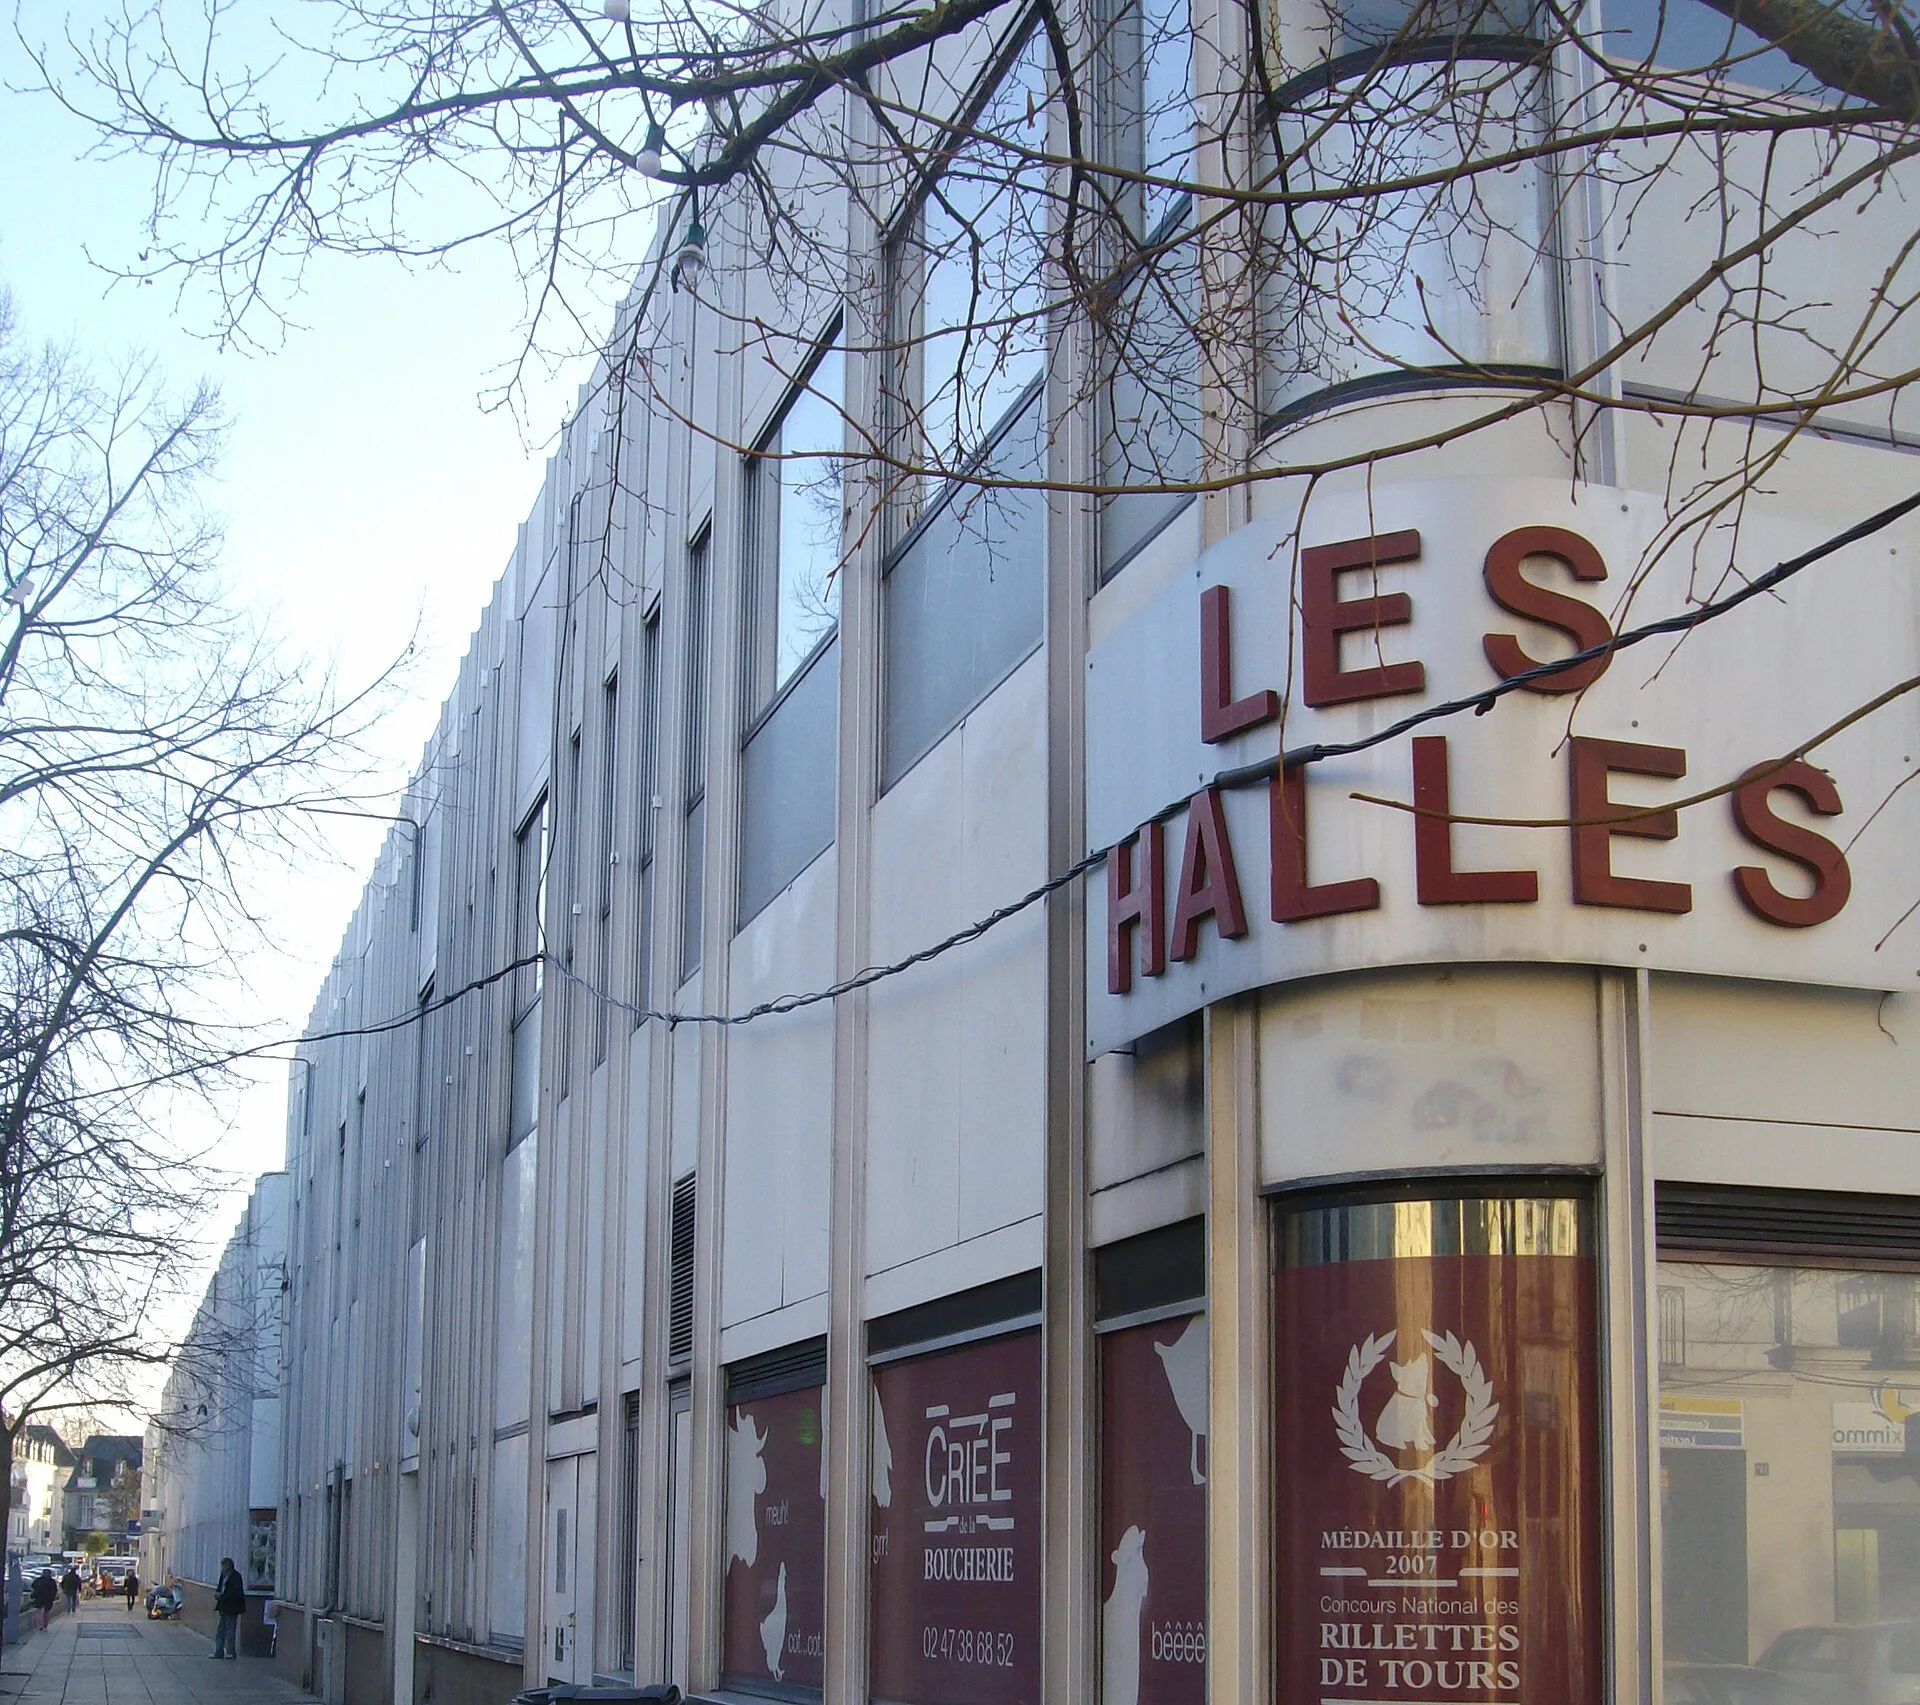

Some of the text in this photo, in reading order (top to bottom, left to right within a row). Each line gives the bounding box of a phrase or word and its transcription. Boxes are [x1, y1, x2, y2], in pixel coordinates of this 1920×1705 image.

[1200, 526, 1615, 744] LES
[1107, 735, 1852, 995] HALLES
[1320, 1526, 1519, 1549] MÉDAILLE D'OR
[924, 1547, 1014, 1582] BOUCHERIE
[1385, 1555, 1438, 1574] 2007
[1320, 1595, 1519, 1614] Concours National des
[923, 1626, 1014, 1667] 02 47 38 68 52
[1320, 1623, 1520, 1651] RILLETTES
[1320, 1658, 1520, 1690] DE TOURS
